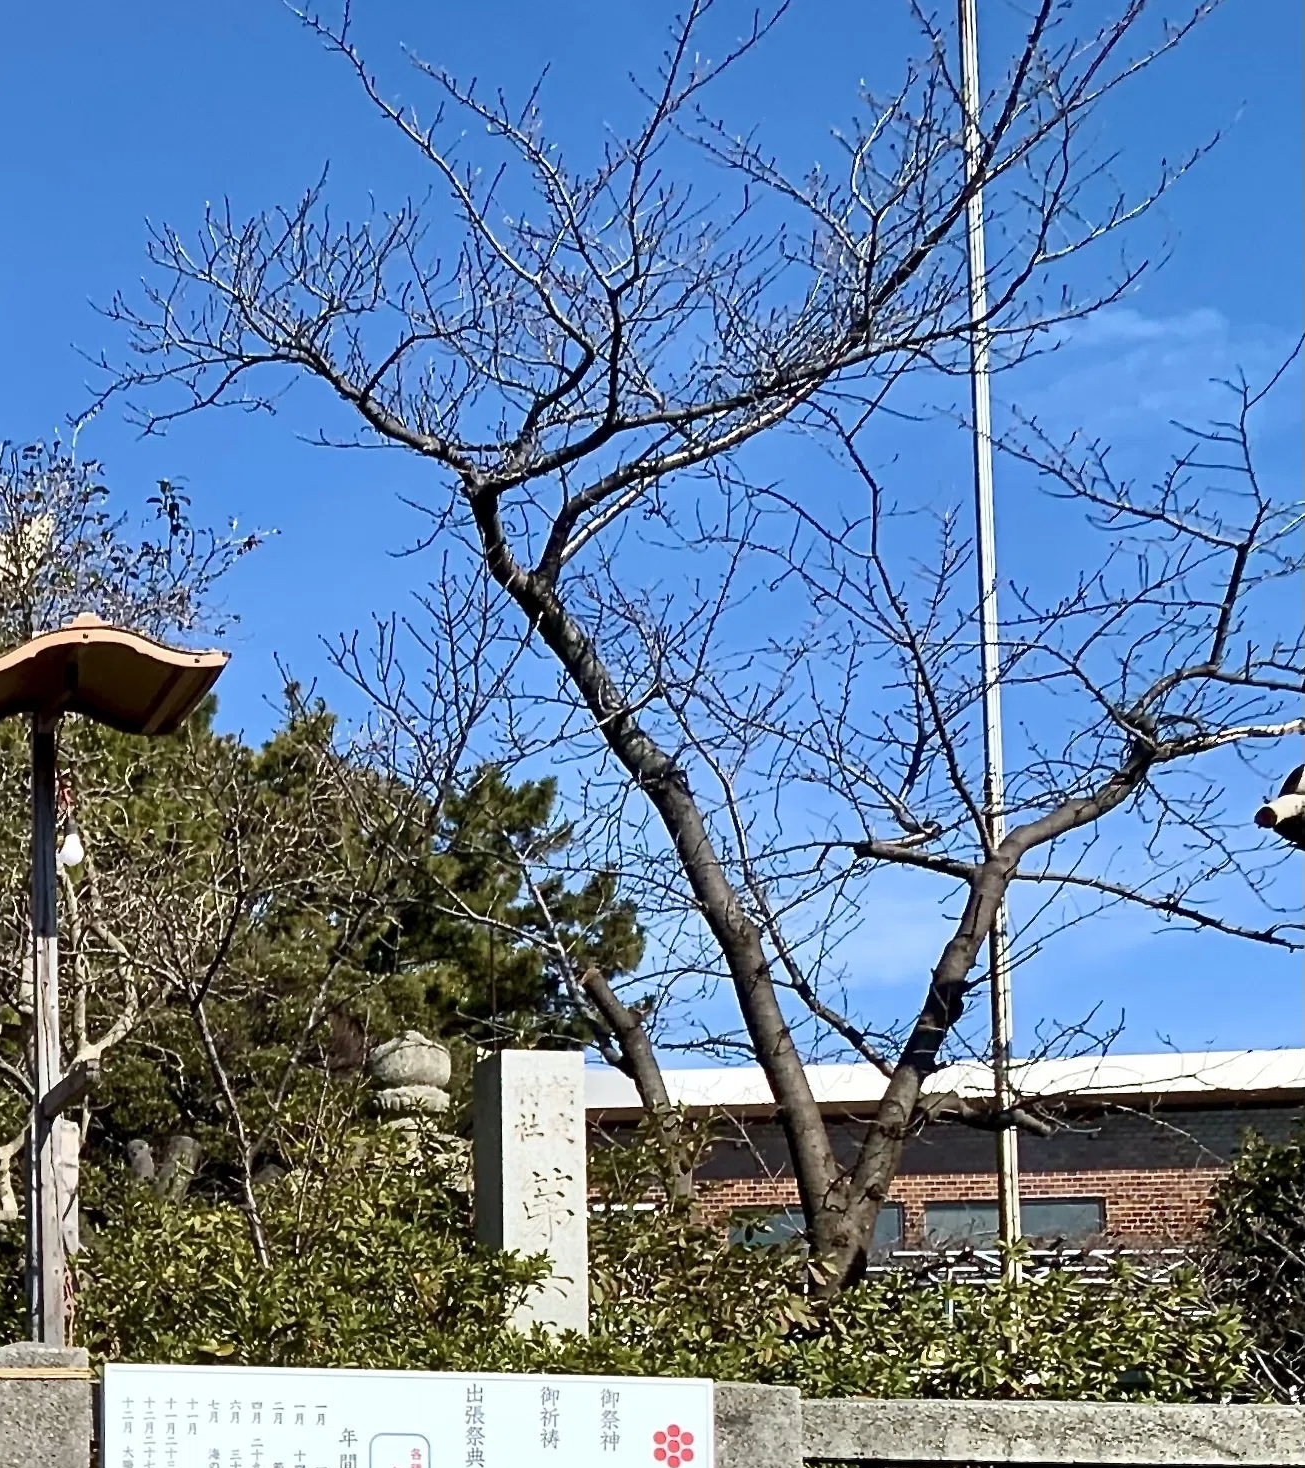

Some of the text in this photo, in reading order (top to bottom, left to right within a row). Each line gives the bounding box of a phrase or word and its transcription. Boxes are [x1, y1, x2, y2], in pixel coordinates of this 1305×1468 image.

[122, 1397, 134, 1434] 十二月
[186, 1398, 199, 1435] 十一月
[208, 1399, 220, 1423] 七月
[230, 1400, 241, 1424] 六月
[251, 1401, 263, 1424] 四月
[272, 1402, 285, 1424] 二月
[294, 1405, 306, 1426] 一月
[315, 1405, 328, 1426] 一月
[540, 1386, 560, 1449] 御祈祷
[600, 1388, 621, 1452] 御祭神
[465, 1383, 485, 1468] 出張祭典
